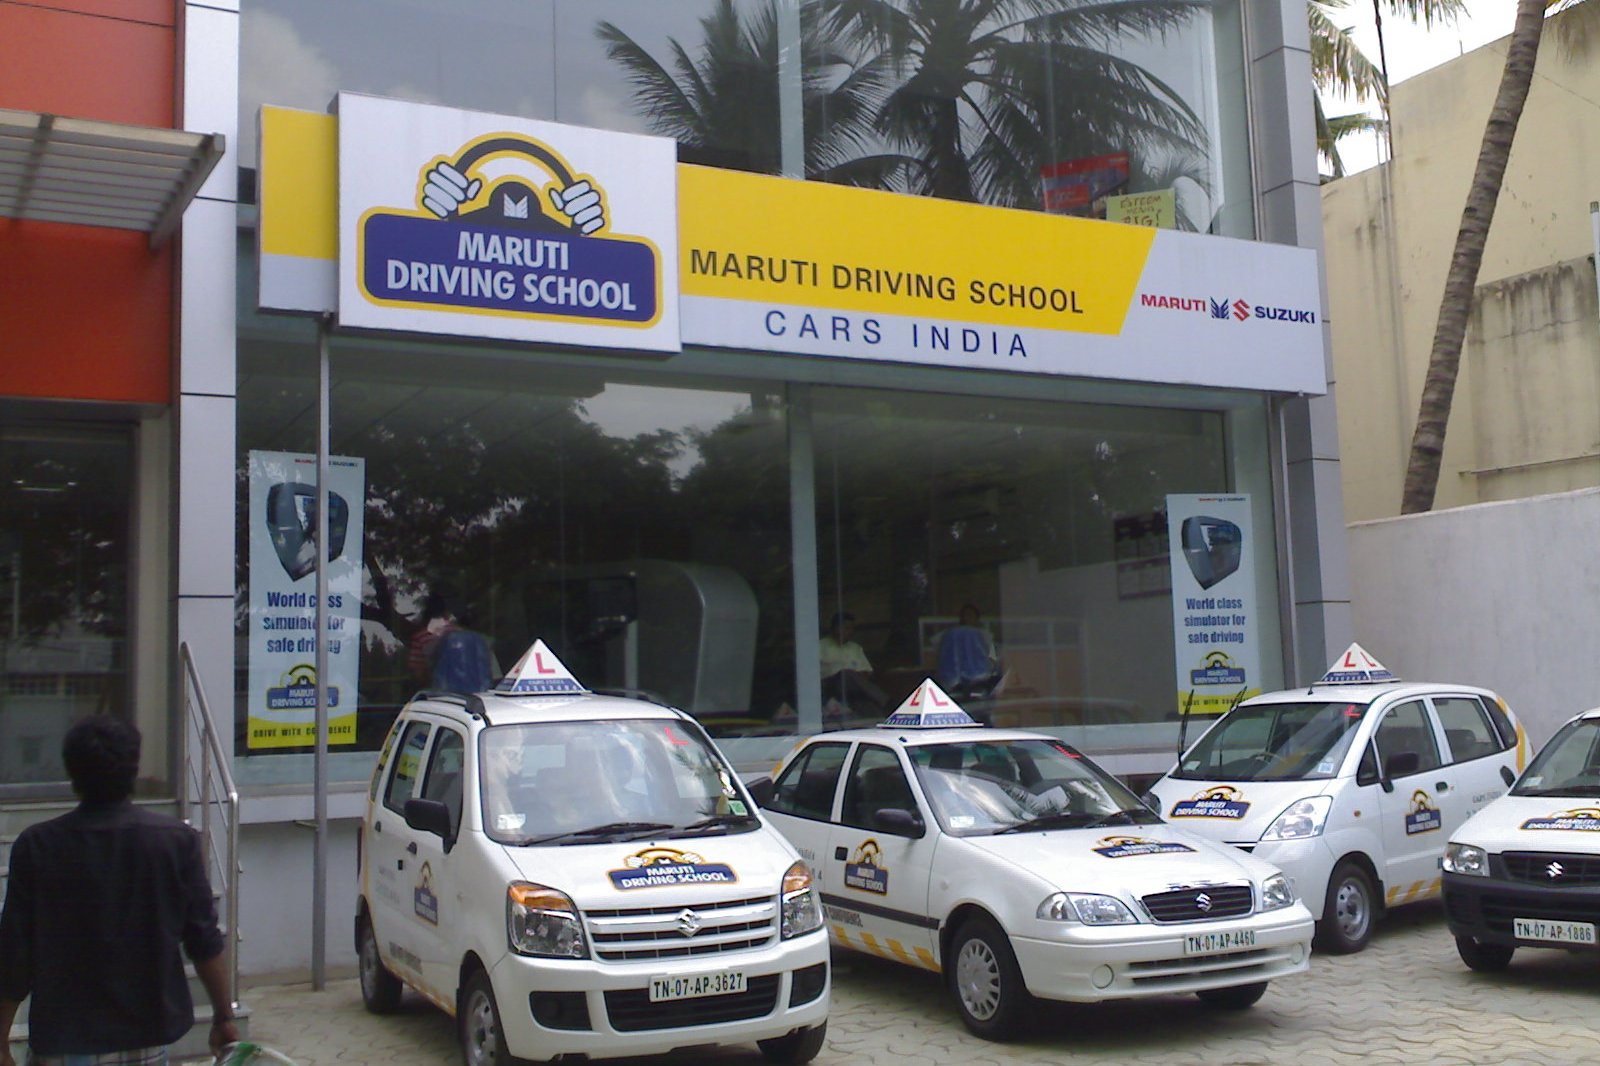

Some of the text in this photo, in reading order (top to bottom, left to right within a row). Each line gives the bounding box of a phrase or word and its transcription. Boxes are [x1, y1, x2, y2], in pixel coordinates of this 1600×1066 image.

[458, 231, 569, 271] MARUTI
[387, 260, 636, 311] DRIVING SCHOOL
[690, 249, 1084, 314] MARUTI DRIVING SCHOOL
[1141, 294, 1315, 323] MARUTI SUZUKI
[765, 311, 1028, 358] CARS INDIA
[267, 592, 342, 608] World css
[1186, 598, 1243, 610] World class
[1184, 614, 1246, 627] simulator for
[267, 638, 294, 653] safe
[1188, 631, 1244, 644] safe driving
[535, 652, 556, 674] L
[1343, 651, 1356, 668] L
[289, 689, 315, 697] MARUT
[928, 687, 949, 706] L
[271, 698, 304, 707] DRIVING
[282, 728, 301, 737] WITH
[664, 727, 689, 746] L
[1208, 808, 1239, 817] SCHOOL
[646, 865, 694, 876] MARUTI
[621, 872, 729, 888] DRIVING SCHOOL
